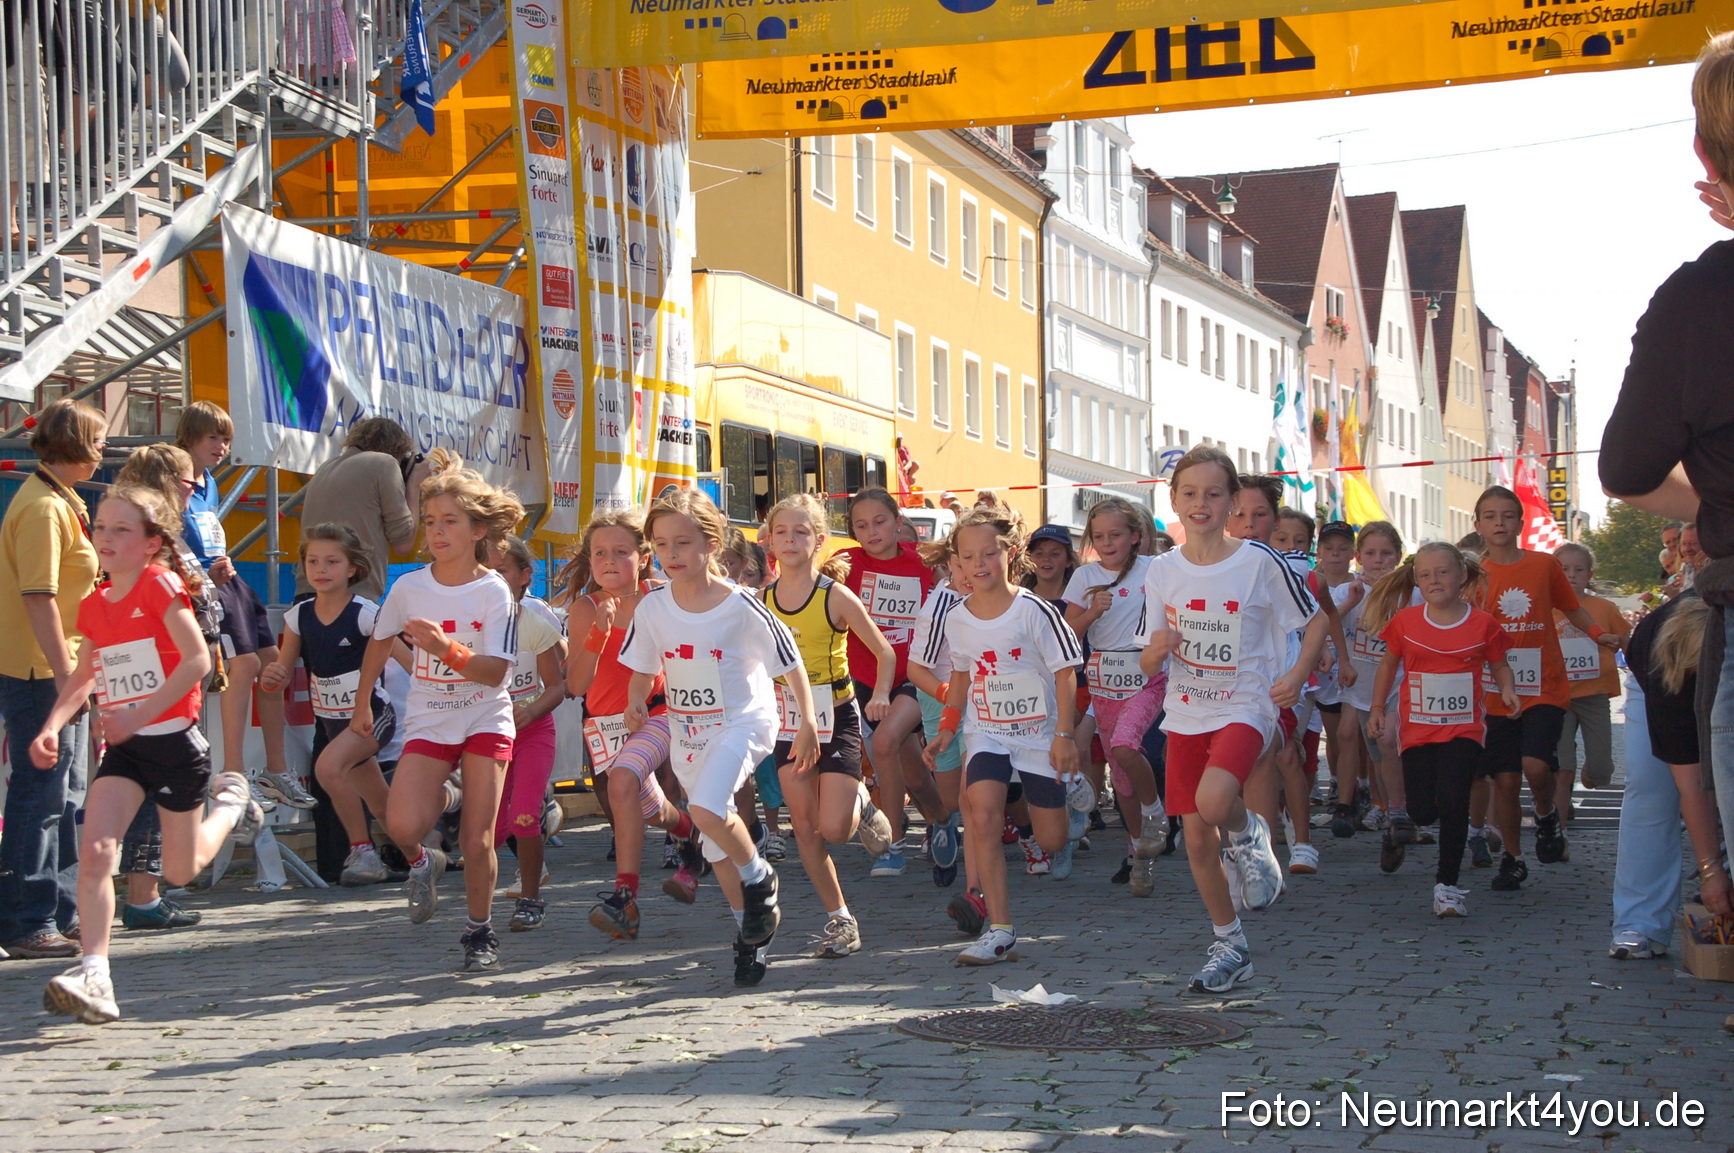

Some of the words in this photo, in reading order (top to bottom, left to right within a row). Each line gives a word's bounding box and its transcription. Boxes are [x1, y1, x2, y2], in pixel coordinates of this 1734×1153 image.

[1452, 9, 1584, 39] Neumarkter
[1588, 0, 1695, 24] Stadtlauf
[746, 75, 863, 95] Neumarkter
[868, 67, 957, 90] Stadtlauf
[529, 164, 568, 187] Sinupret
[531, 185, 558, 203] forte
[323, 272, 530, 413] PFLEIDERER
[542, 336, 580, 353] HACKNER
[878, 579, 901, 591] Nadia
[861, 591, 870, 600] K3
[877, 597, 917, 614] 7037
[1179, 614, 1230, 633] Franziska
[1182, 638, 1232, 662] 7146
[1371, 639, 1388, 653] 72
[433, 659, 454, 677] 72
[1102, 656, 1125, 667] Marie
[109, 670, 159, 697] 7103
[514, 671, 533, 687] 65
[1103, 673, 1143, 688] 7088
[1516, 669, 1536, 683] 13
[988, 680, 1014, 692] Helen
[670, 688, 716, 707] 7263
[1426, 695, 1468, 711] 7189
[992, 696, 1039, 717] 7067
[600, 719, 628, 733] Antoni
[590, 738, 601, 748] K3
